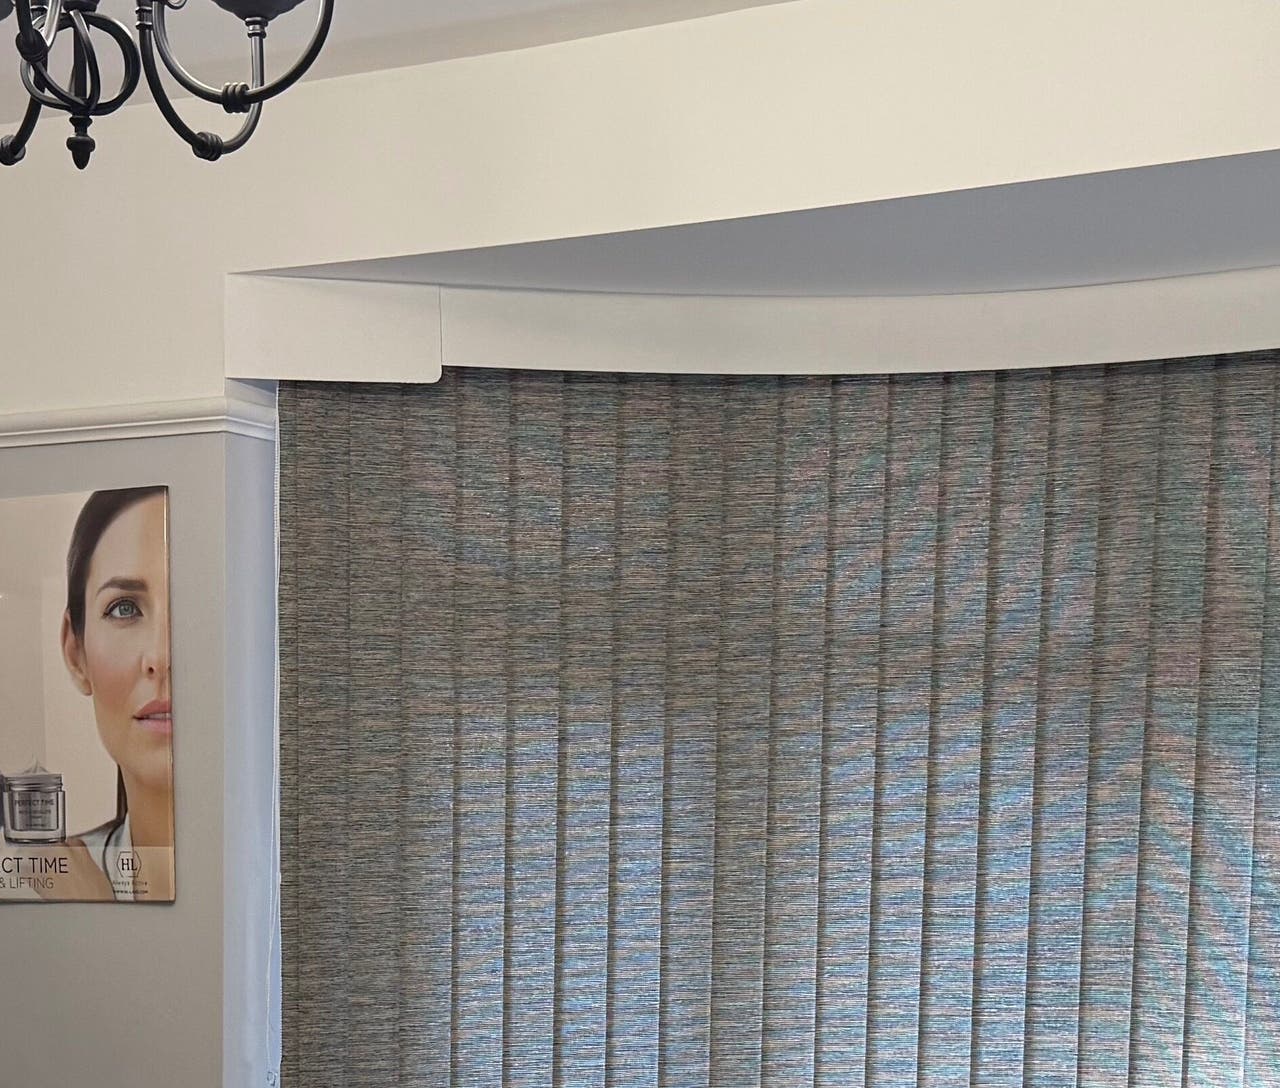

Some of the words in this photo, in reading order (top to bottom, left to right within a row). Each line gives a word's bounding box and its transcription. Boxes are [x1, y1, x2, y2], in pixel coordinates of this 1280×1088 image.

[28, 857, 69, 873] TIME
[121, 858, 137, 871] HL
[9, 877, 54, 889] LIFTING
